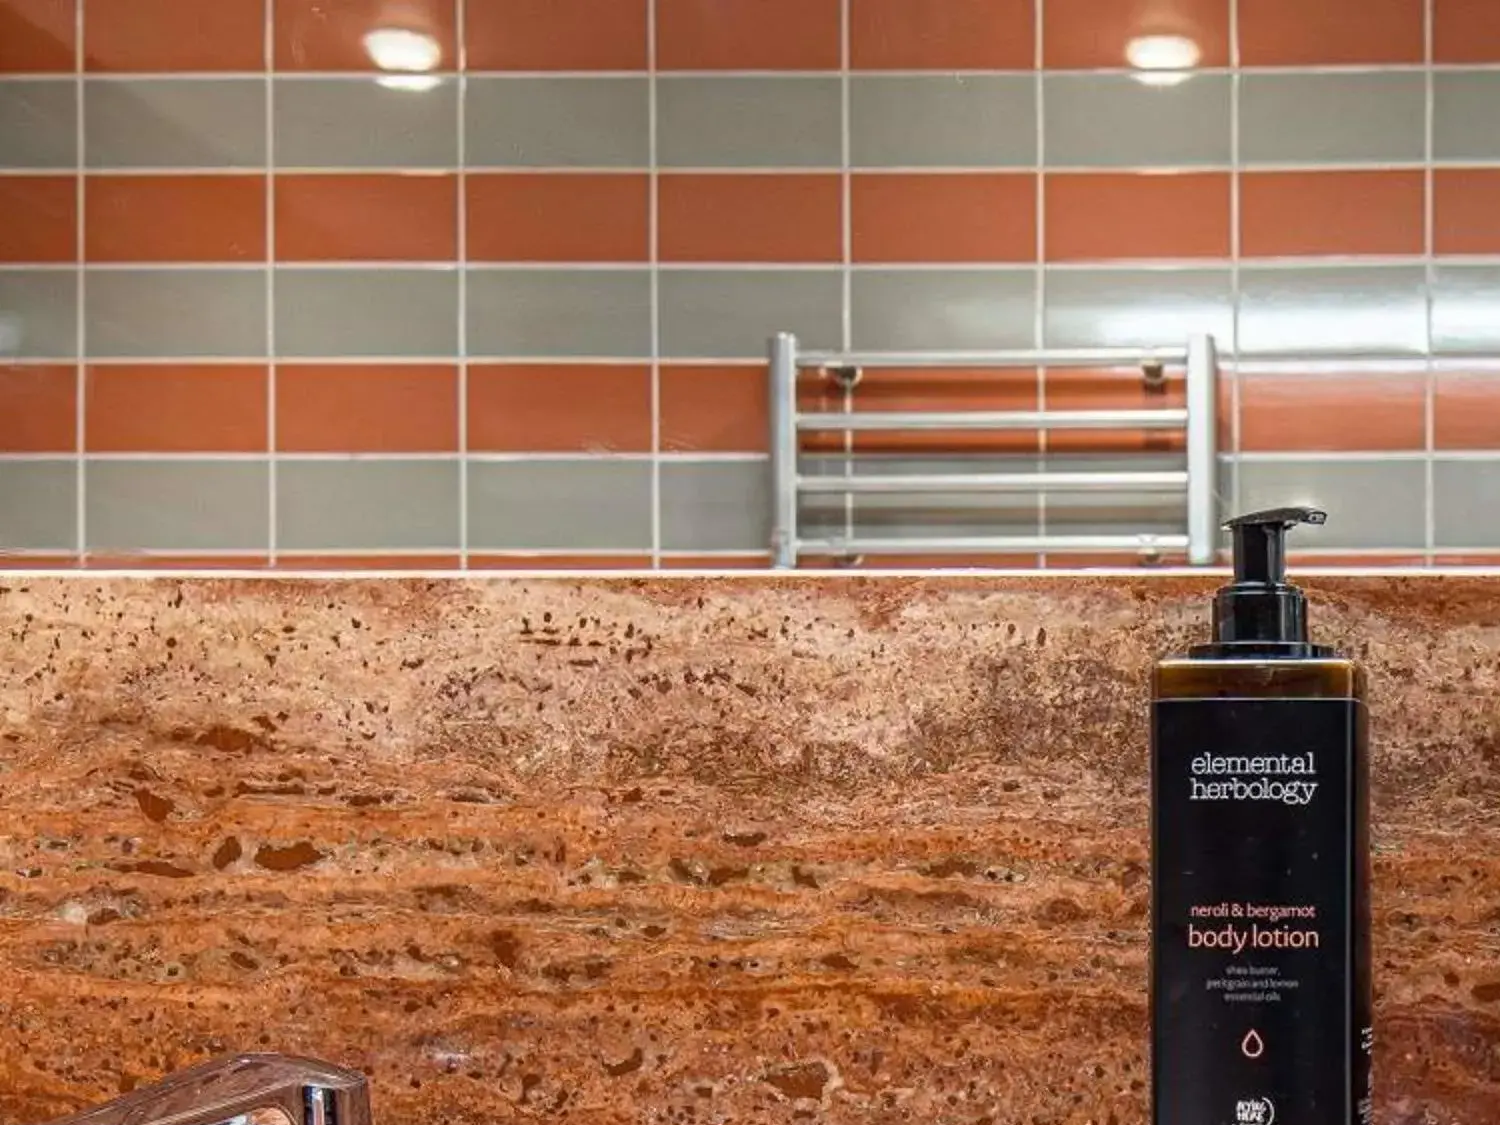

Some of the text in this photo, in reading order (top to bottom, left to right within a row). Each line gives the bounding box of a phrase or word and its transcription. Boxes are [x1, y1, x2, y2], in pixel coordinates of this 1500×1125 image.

[1191, 752, 1316, 775] elemental
[1189, 777, 1318, 804] herbology
[1191, 903, 1316, 921] neroli & bergamot
[1188, 924, 1319, 955] body lotion
